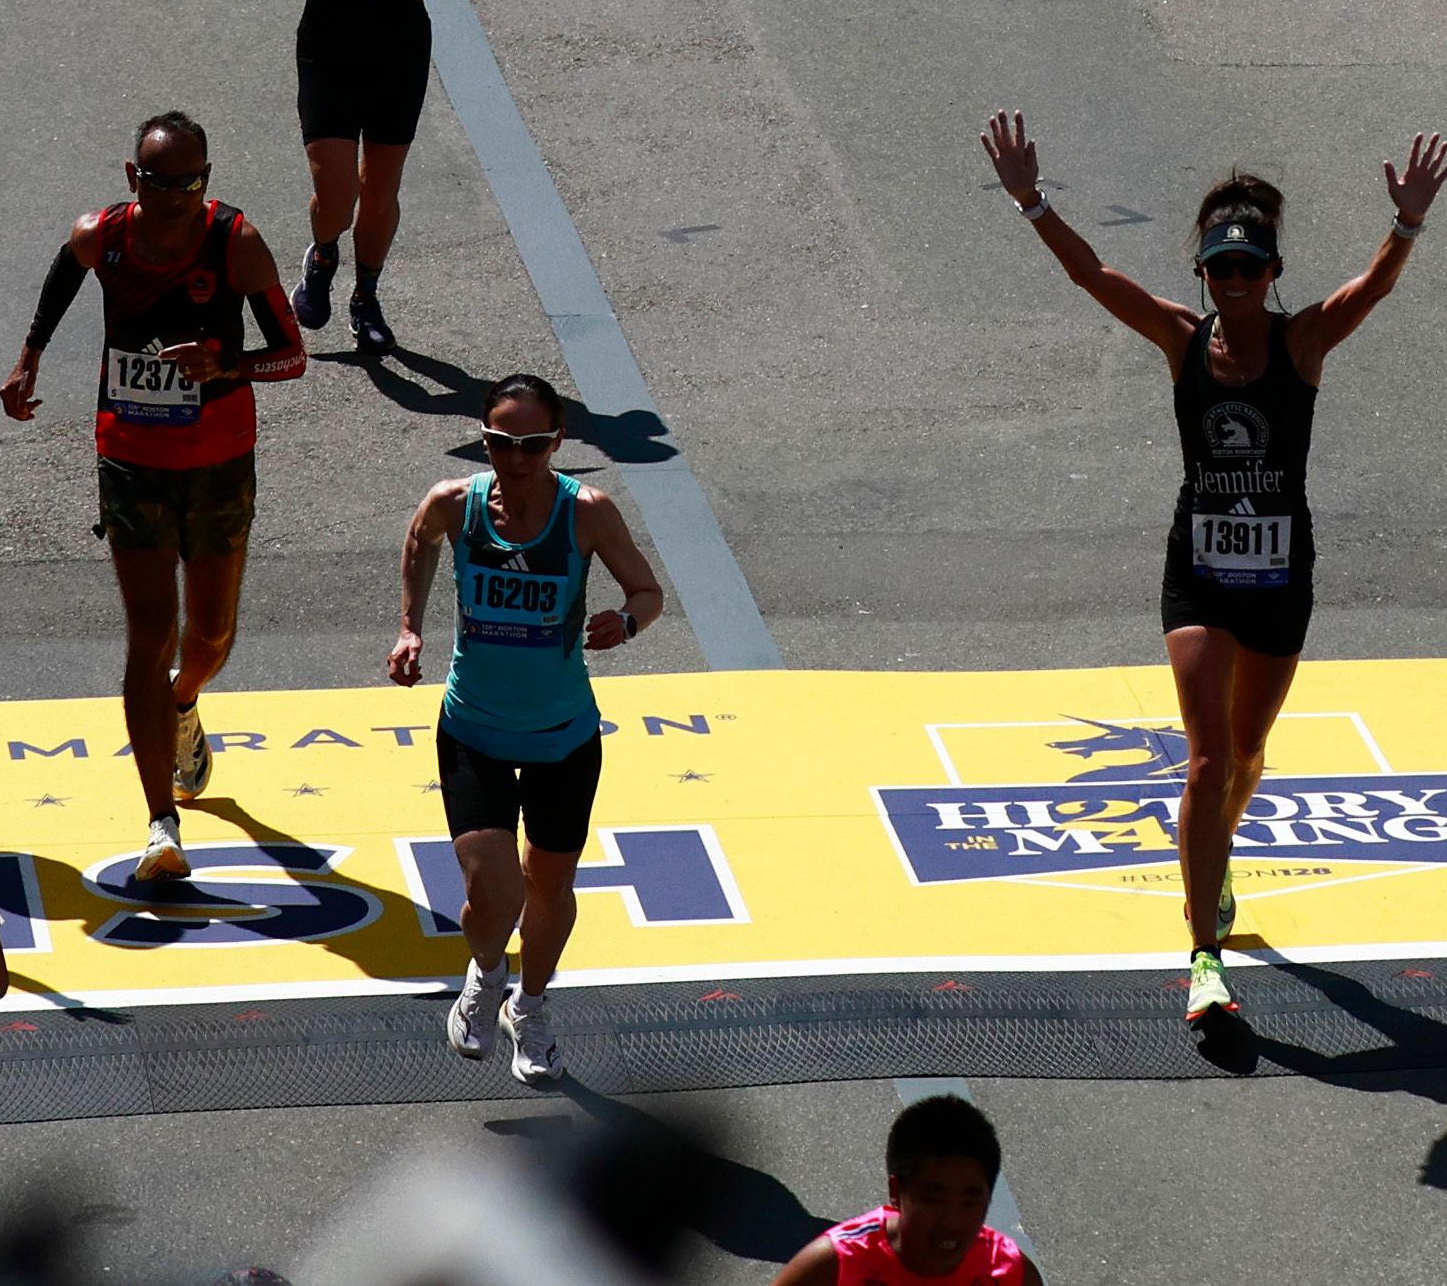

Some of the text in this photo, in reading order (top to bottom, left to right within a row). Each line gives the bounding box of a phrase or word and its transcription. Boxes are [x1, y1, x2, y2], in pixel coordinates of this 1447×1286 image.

[1193, 462, 1285, 498] Jennifer
[1202, 518, 1280, 556] 13911
[472, 575, 556, 613] 16203
